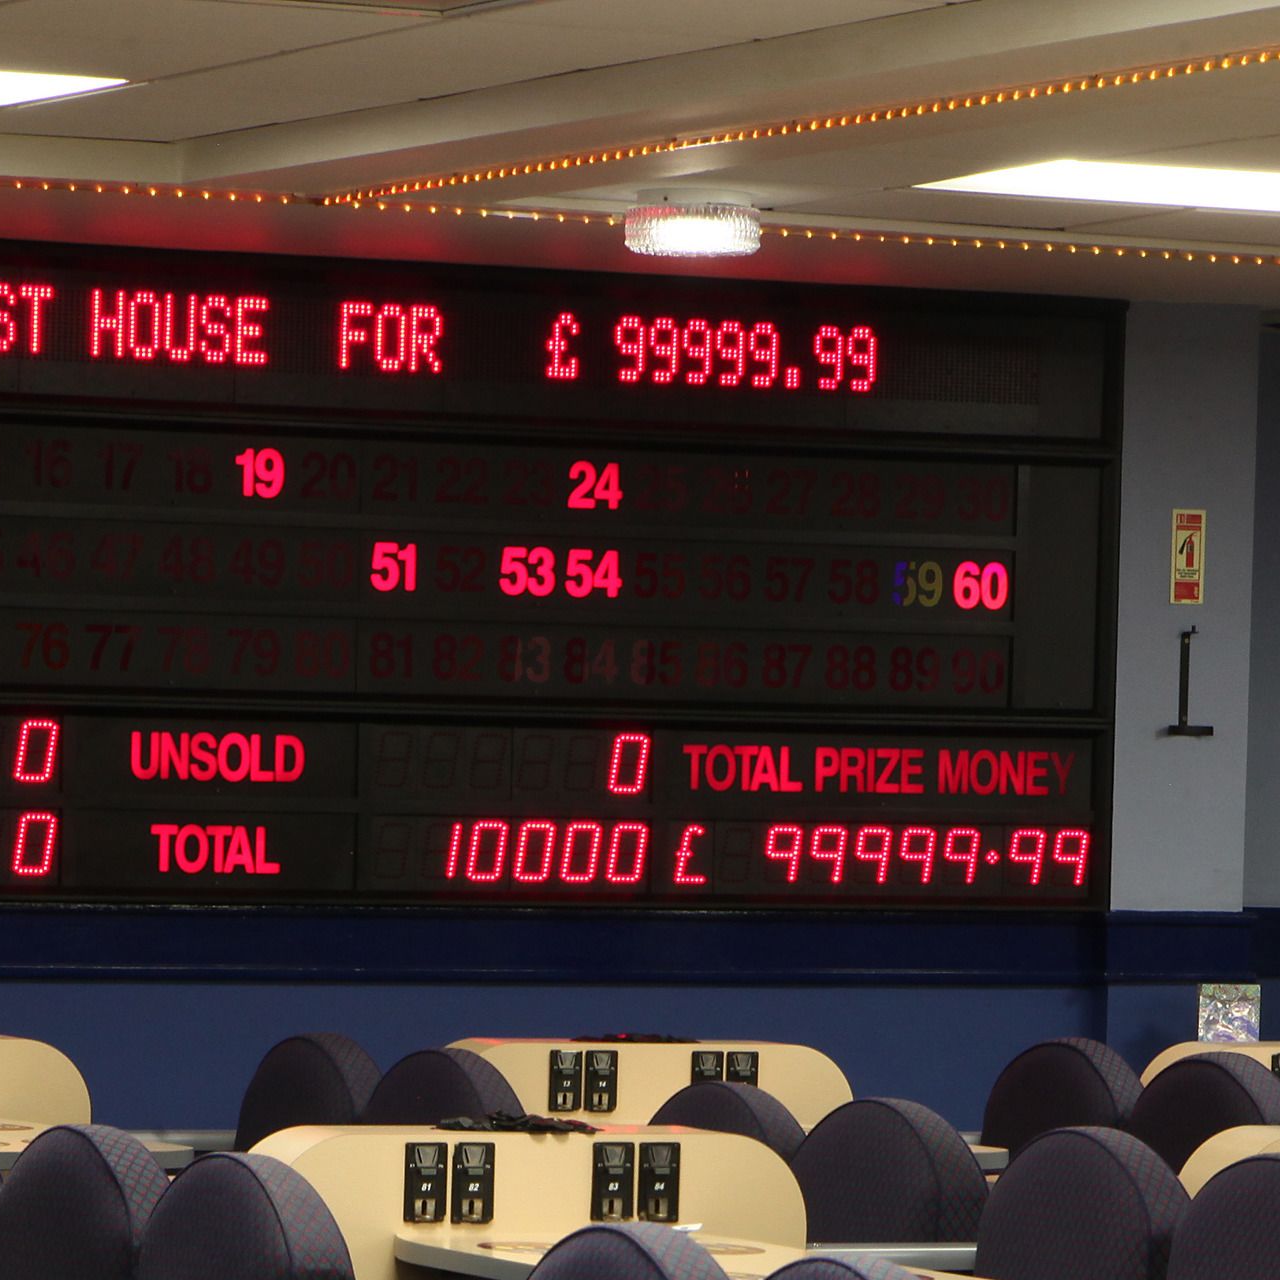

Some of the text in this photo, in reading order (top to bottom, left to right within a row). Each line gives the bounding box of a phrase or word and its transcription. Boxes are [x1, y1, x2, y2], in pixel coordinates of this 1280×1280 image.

[91, 287, 269, 366] HOUSE
[339, 301, 442, 373] FOR
[546, 312, 580, 381] £
[614, 315, 877, 393] 99999.99
[235, 448, 285, 498] 19
[568, 460, 621, 509] 24
[370, 542, 417, 591] 51
[499, 546, 555, 596] 53
[565, 549, 622, 597] 54
[634, 553, 686, 596] 55
[762, 558, 812, 601] 57
[828, 559, 879, 603] 58
[892, 561, 943, 608] 59
[953, 562, 1008, 610] 60
[20, 623, 70, 669] 76
[89, 625, 139, 671] 77
[369, 633, 414, 679] 81
[432, 634, 484, 680] 82
[631, 639, 682, 686] 85
[762, 642, 812, 689] 87
[826, 645, 876, 691] 88
[889, 647, 940, 692] 89
[15, 718, 60, 784] 0
[131, 730, 306, 784] UNSOLD
[608, 733, 651, 795] 0
[683, 743, 802, 793] TOTAL
[814, 747, 925, 795] PRIZE
[937, 748, 1075, 797] MONEY
[13, 810, 57, 876] 0
[150, 823, 281, 875] TOTAL
[444, 819, 649, 885] 10000
[421, 1183, 432, 1191] 81
[468, 1183, 480, 1192] 82
[608, 1182, 619, 1191] 83
[654, 1182, 665, 1191] 84
